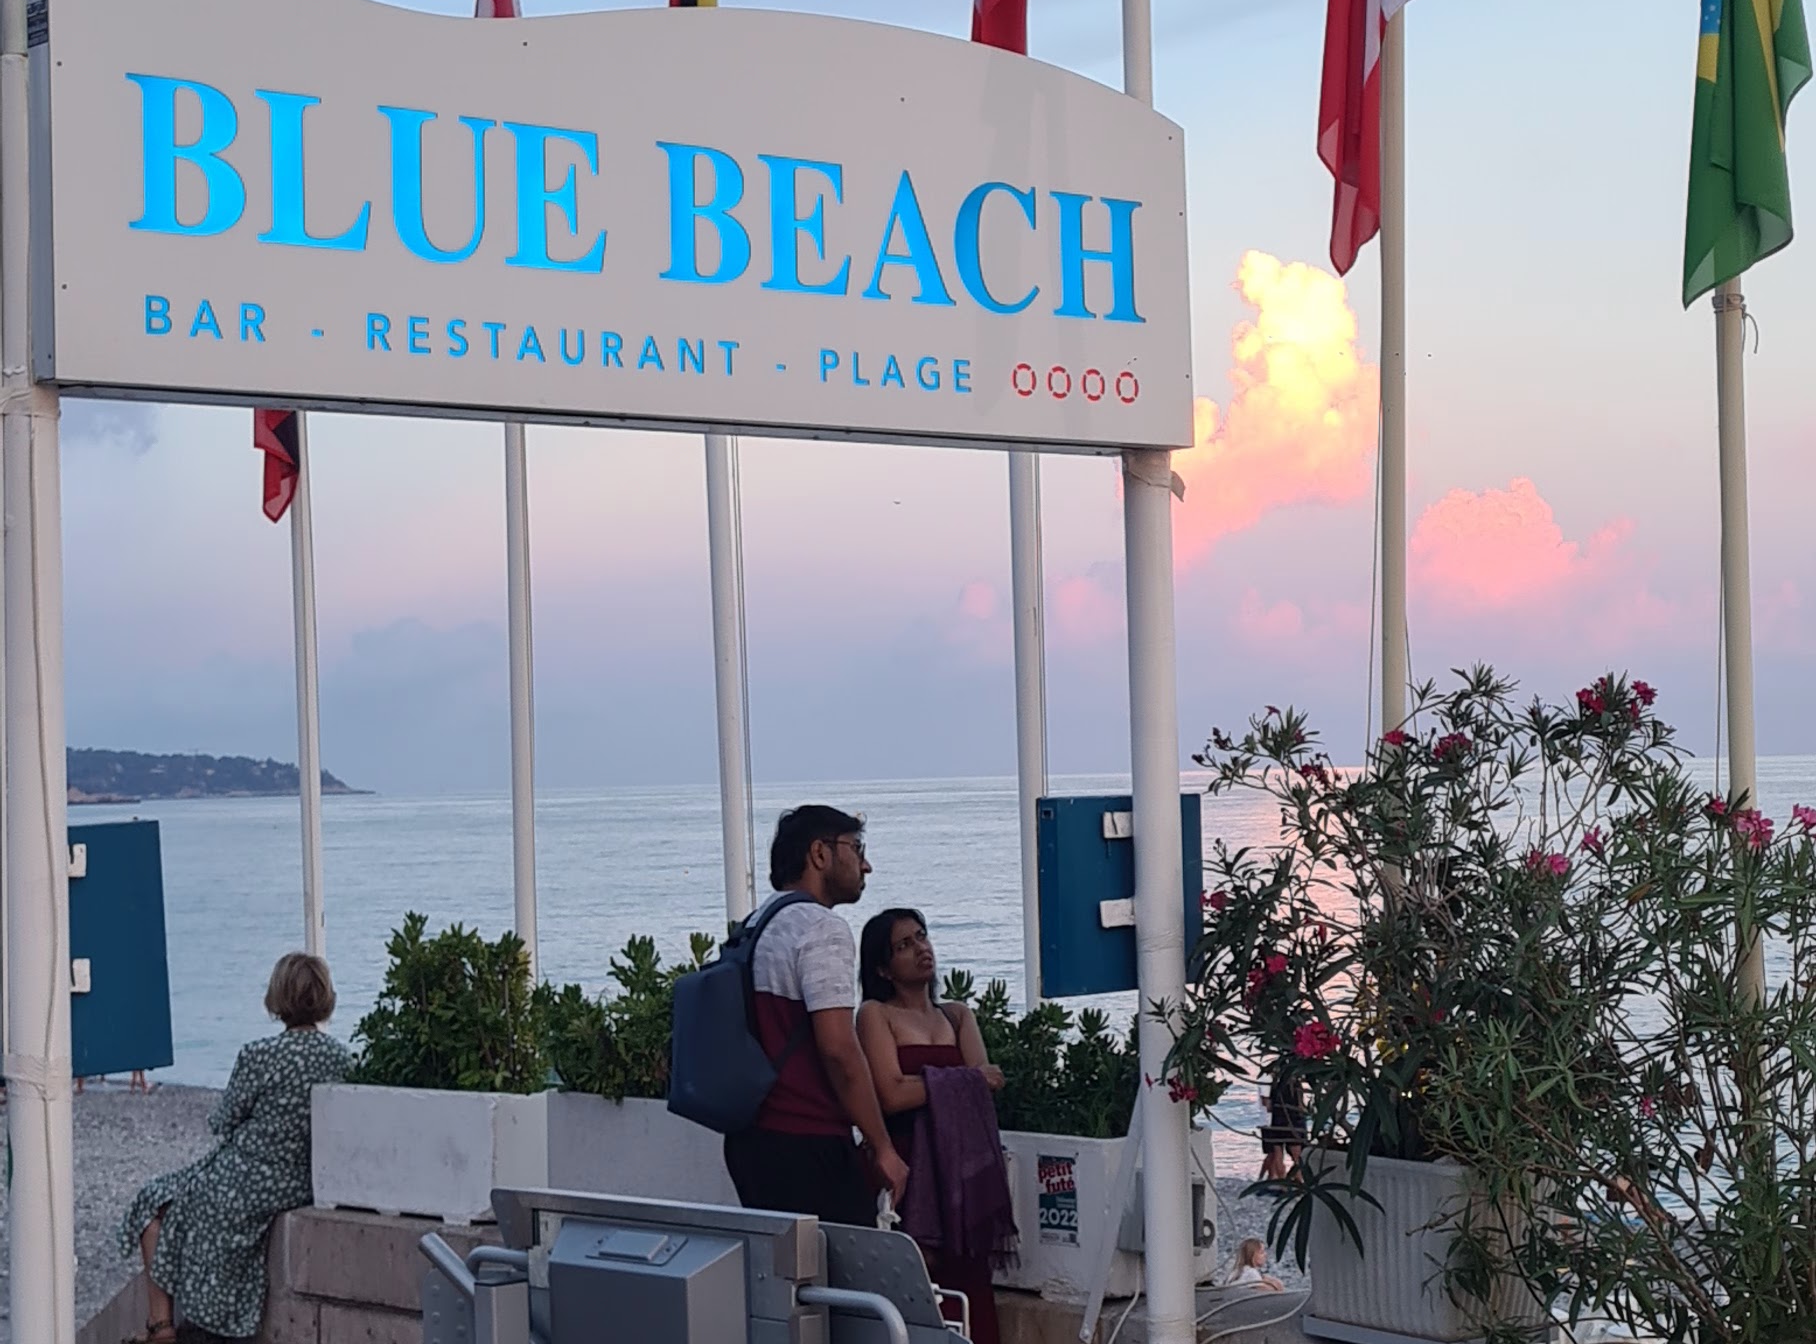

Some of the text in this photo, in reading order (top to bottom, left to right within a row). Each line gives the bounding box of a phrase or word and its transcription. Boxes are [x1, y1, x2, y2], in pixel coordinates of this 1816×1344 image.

[124, 72, 1146, 324] BLUE BEACH
[143, 294, 267, 344] BAR
[366, 312, 740, 376] RESTAURANT
[819, 348, 975, 395] PLAGE
[1038, 1162, 1073, 1184] petit
[1045, 1176, 1075, 1193] futé
[1039, 1207, 1078, 1227] 2022
